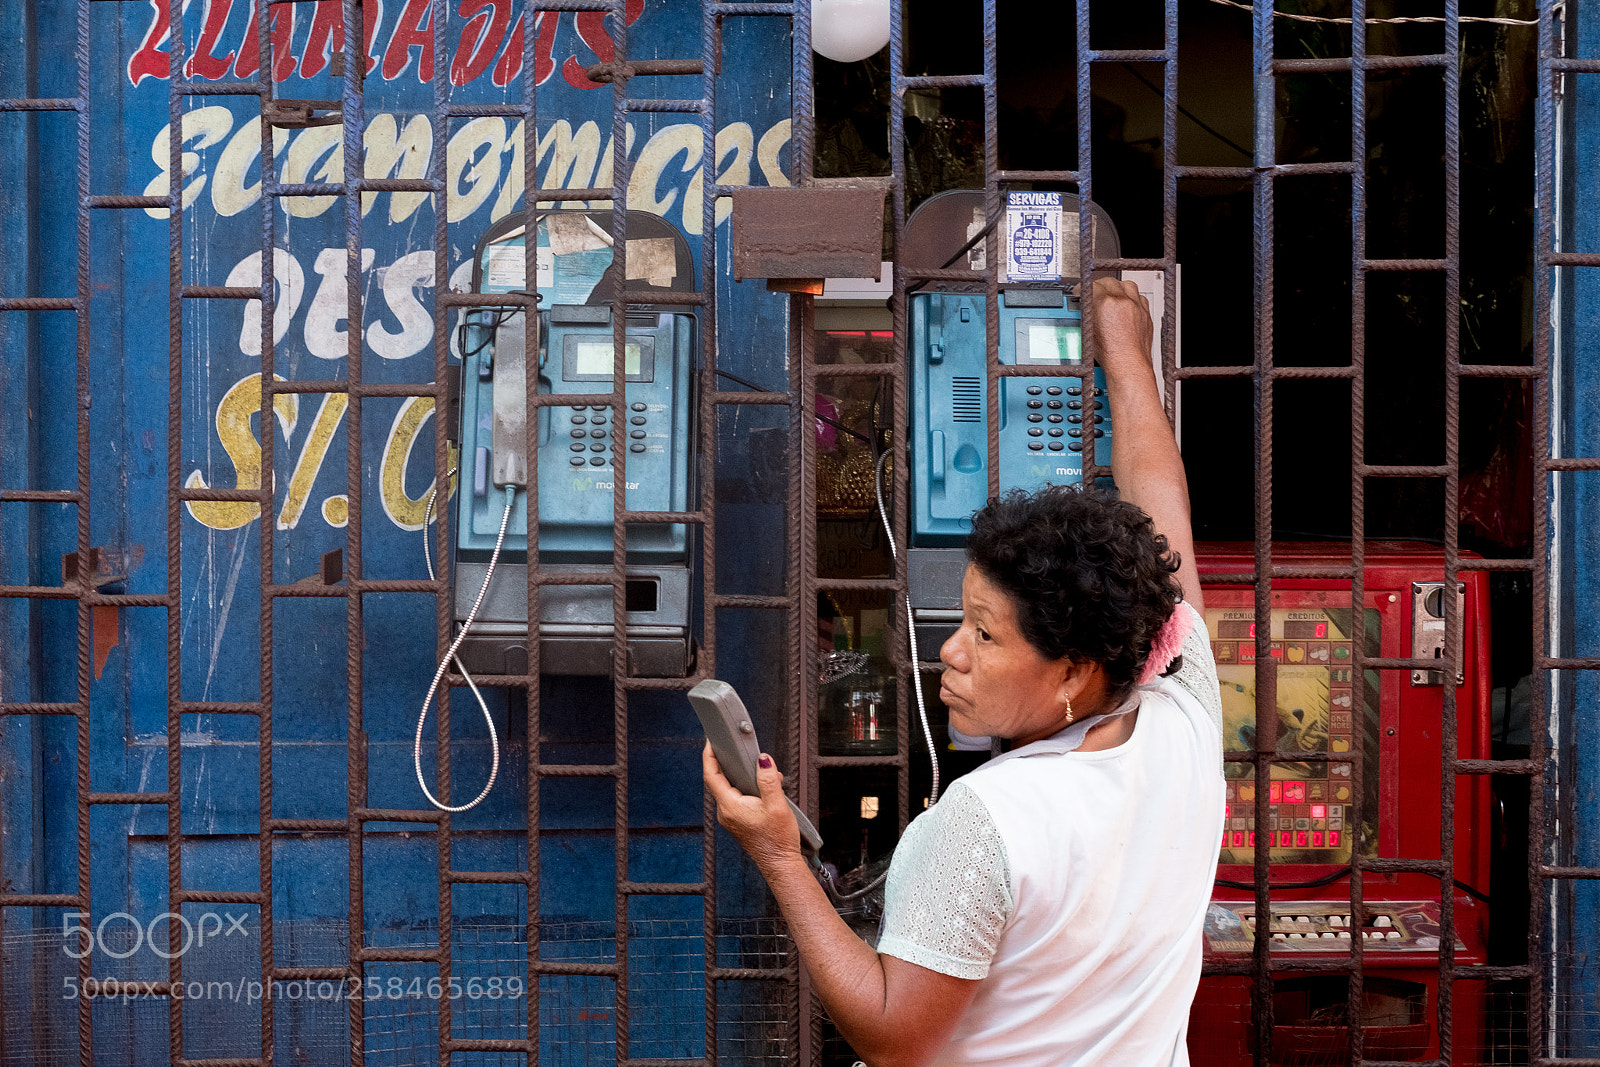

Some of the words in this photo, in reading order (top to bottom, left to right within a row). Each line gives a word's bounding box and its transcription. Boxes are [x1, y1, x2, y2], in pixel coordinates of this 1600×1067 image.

[1009, 193, 1060, 206] SERVIGAS
[224, 248, 473, 360] DES
[1056, 467, 1082, 476] movi
[596, 481, 640, 490] movtar
[1287, 612, 1325, 620] CREDITOS
